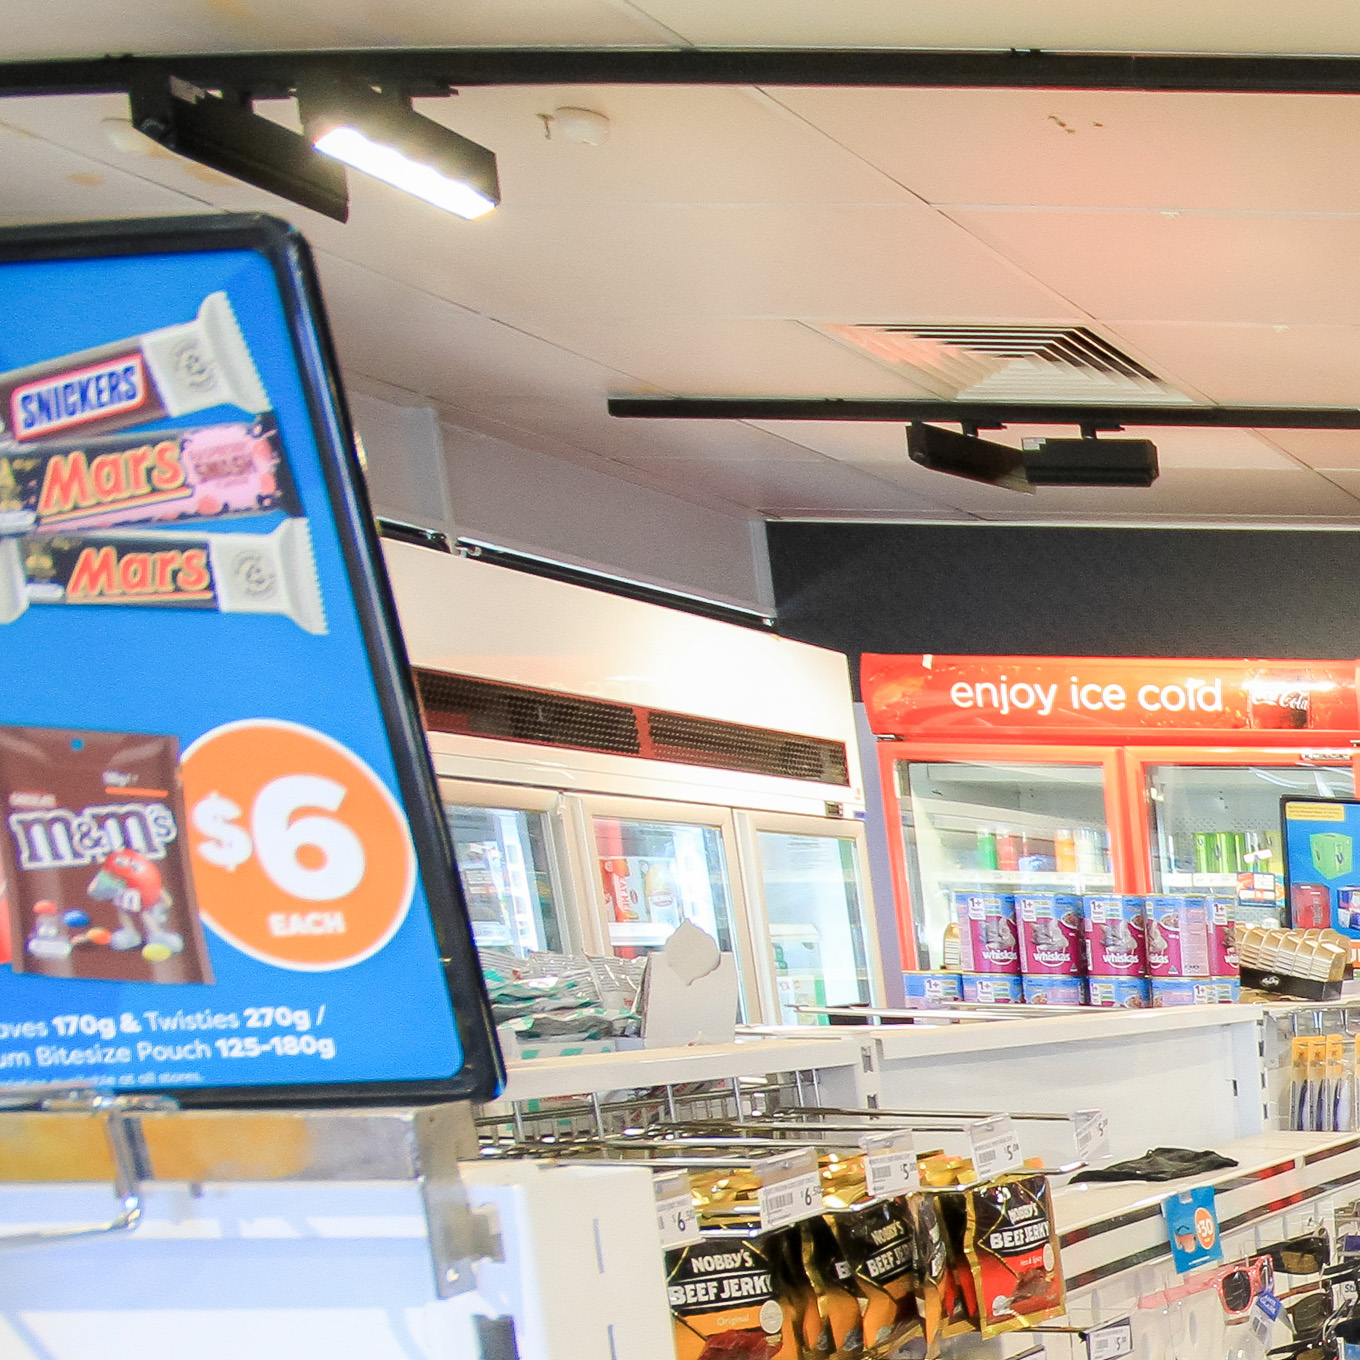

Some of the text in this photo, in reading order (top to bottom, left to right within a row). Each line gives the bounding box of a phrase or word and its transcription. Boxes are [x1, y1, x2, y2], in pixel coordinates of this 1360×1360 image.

[20, 365, 139, 428] SNICKERS
[39, 441, 186, 516] Mars
[66, 547, 209, 596] Mars
[951, 677, 1057, 715] enjoy
[1071, 677, 1126, 710] ice
[1138, 679, 1222, 712] cold
[192, 774, 366, 901] $6
[969, 898, 982, 907] 1+
[1022, 900, 1033, 909] 1+
[268, 912, 346, 938] EACH
[983, 950, 1017, 961] whiskas
[1033, 950, 1071, 961] whiskas
[1102, 953, 1138, 964] whiskas
[53, 1006, 312, 1039] 170g & Twisties 270g
[36, 1035, 336, 1067] Bitesize Pouch 125-180g
[800, 1185, 821, 1206] $6.50
[1007, 1201, 1039, 1222] NOBBY'S
[871, 1219, 904, 1246] NOBBY'S
[990, 1220, 1050, 1249] BEEF JERKY
[1196, 1219, 1214, 1239] $30
[692, 1251, 754, 1273] NOBBY'S
[867, 1254, 895, 1277] BEEF
[668, 1279, 718, 1305] BEEF
[717, 1314, 749, 1326] Original
